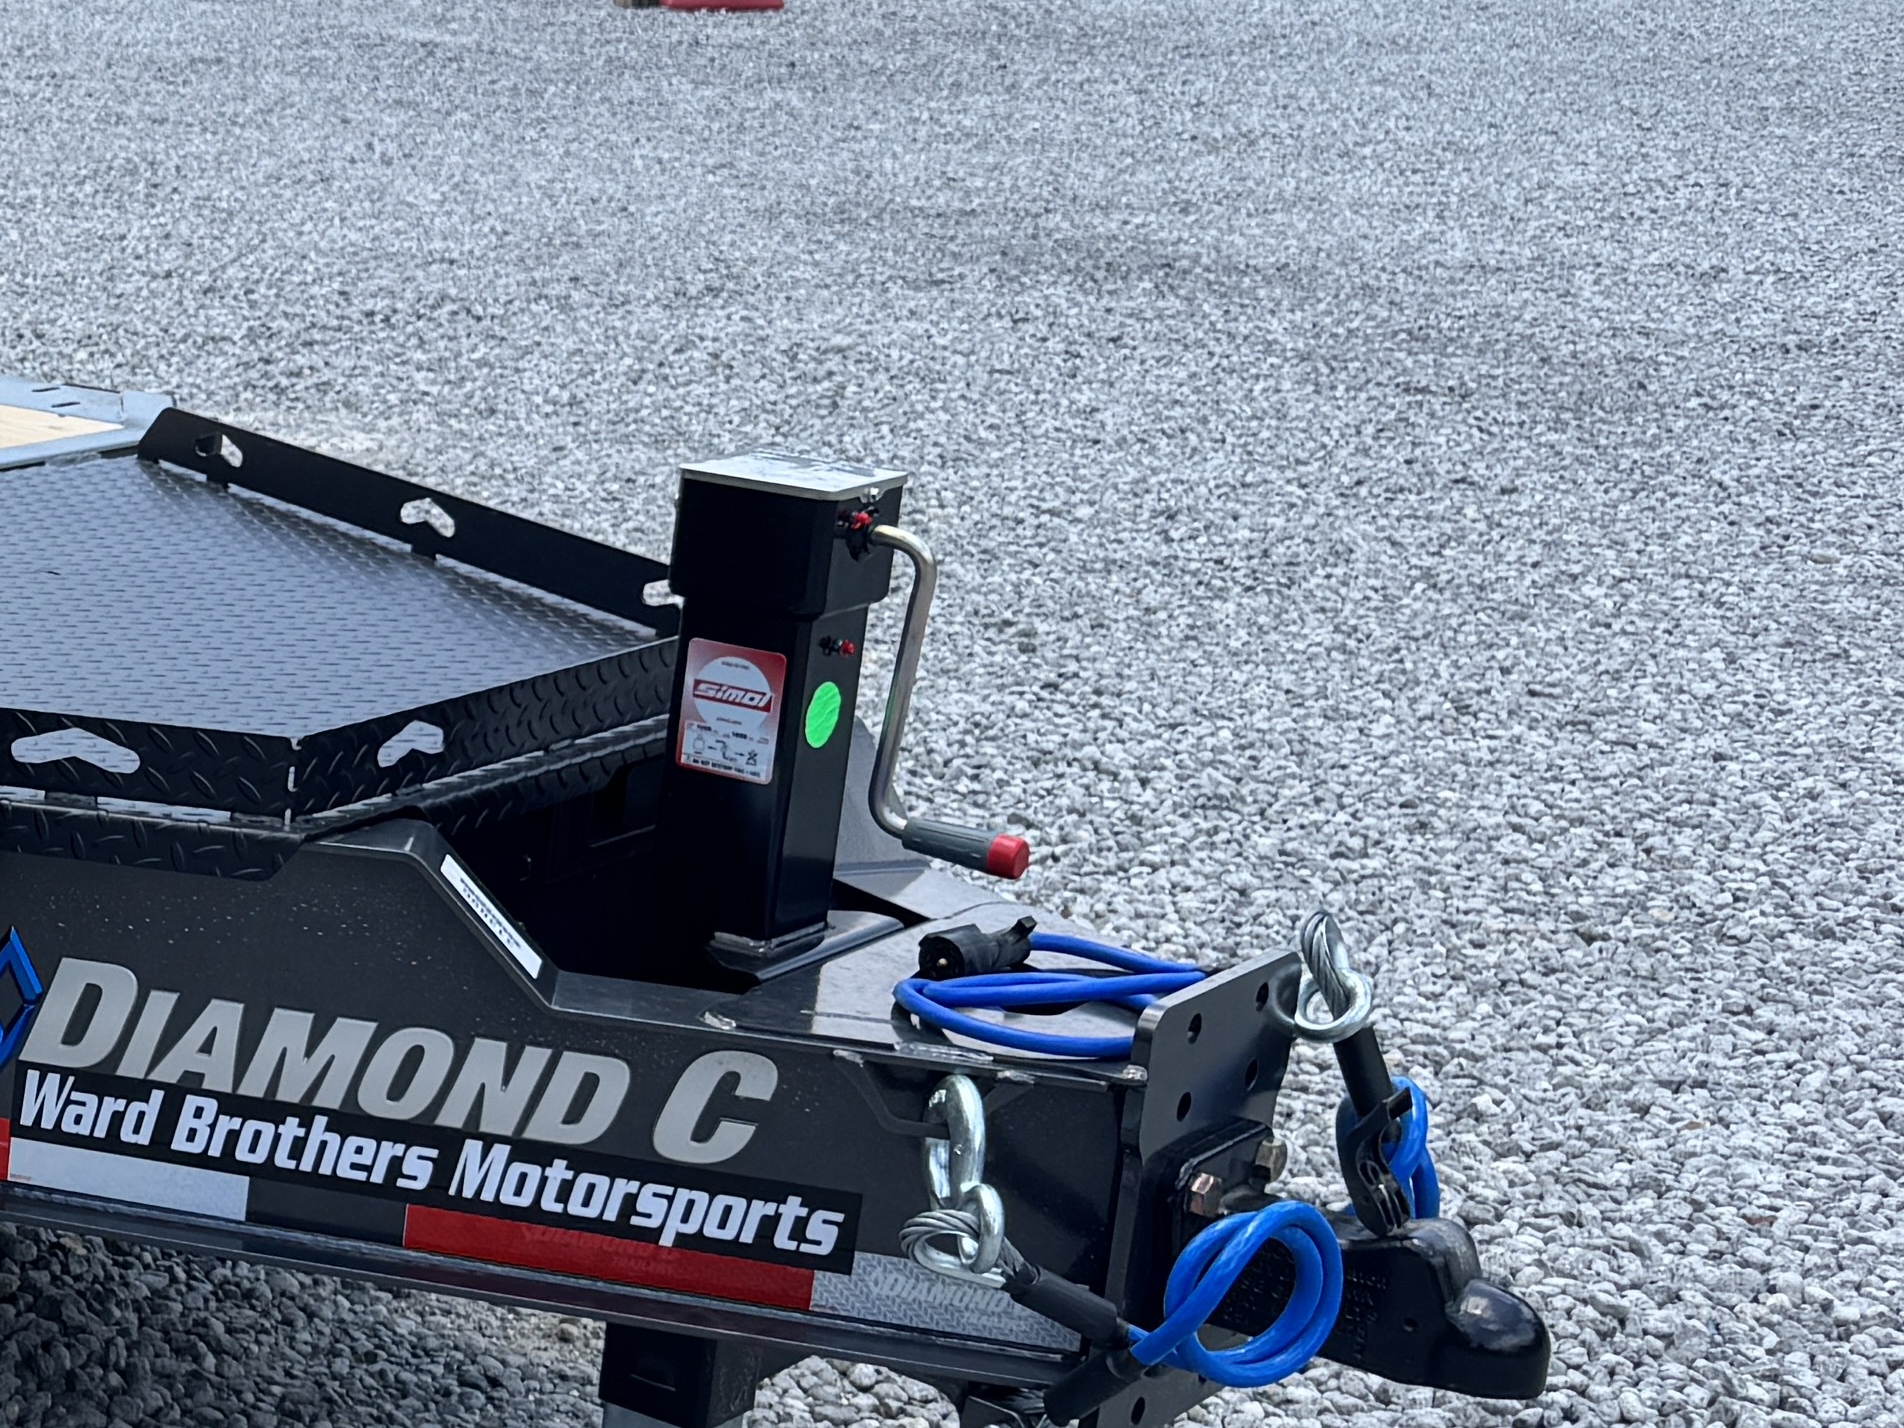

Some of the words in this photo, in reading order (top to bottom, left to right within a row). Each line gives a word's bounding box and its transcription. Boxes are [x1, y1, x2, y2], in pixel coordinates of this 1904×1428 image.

[18, 956, 631, 1146] DIAMOND
[652, 1049, 779, 1165] C
[19, 1068, 165, 1147] Ward
[170, 1093, 440, 1191] Brothers
[448, 1137, 846, 1257] Motorsports
